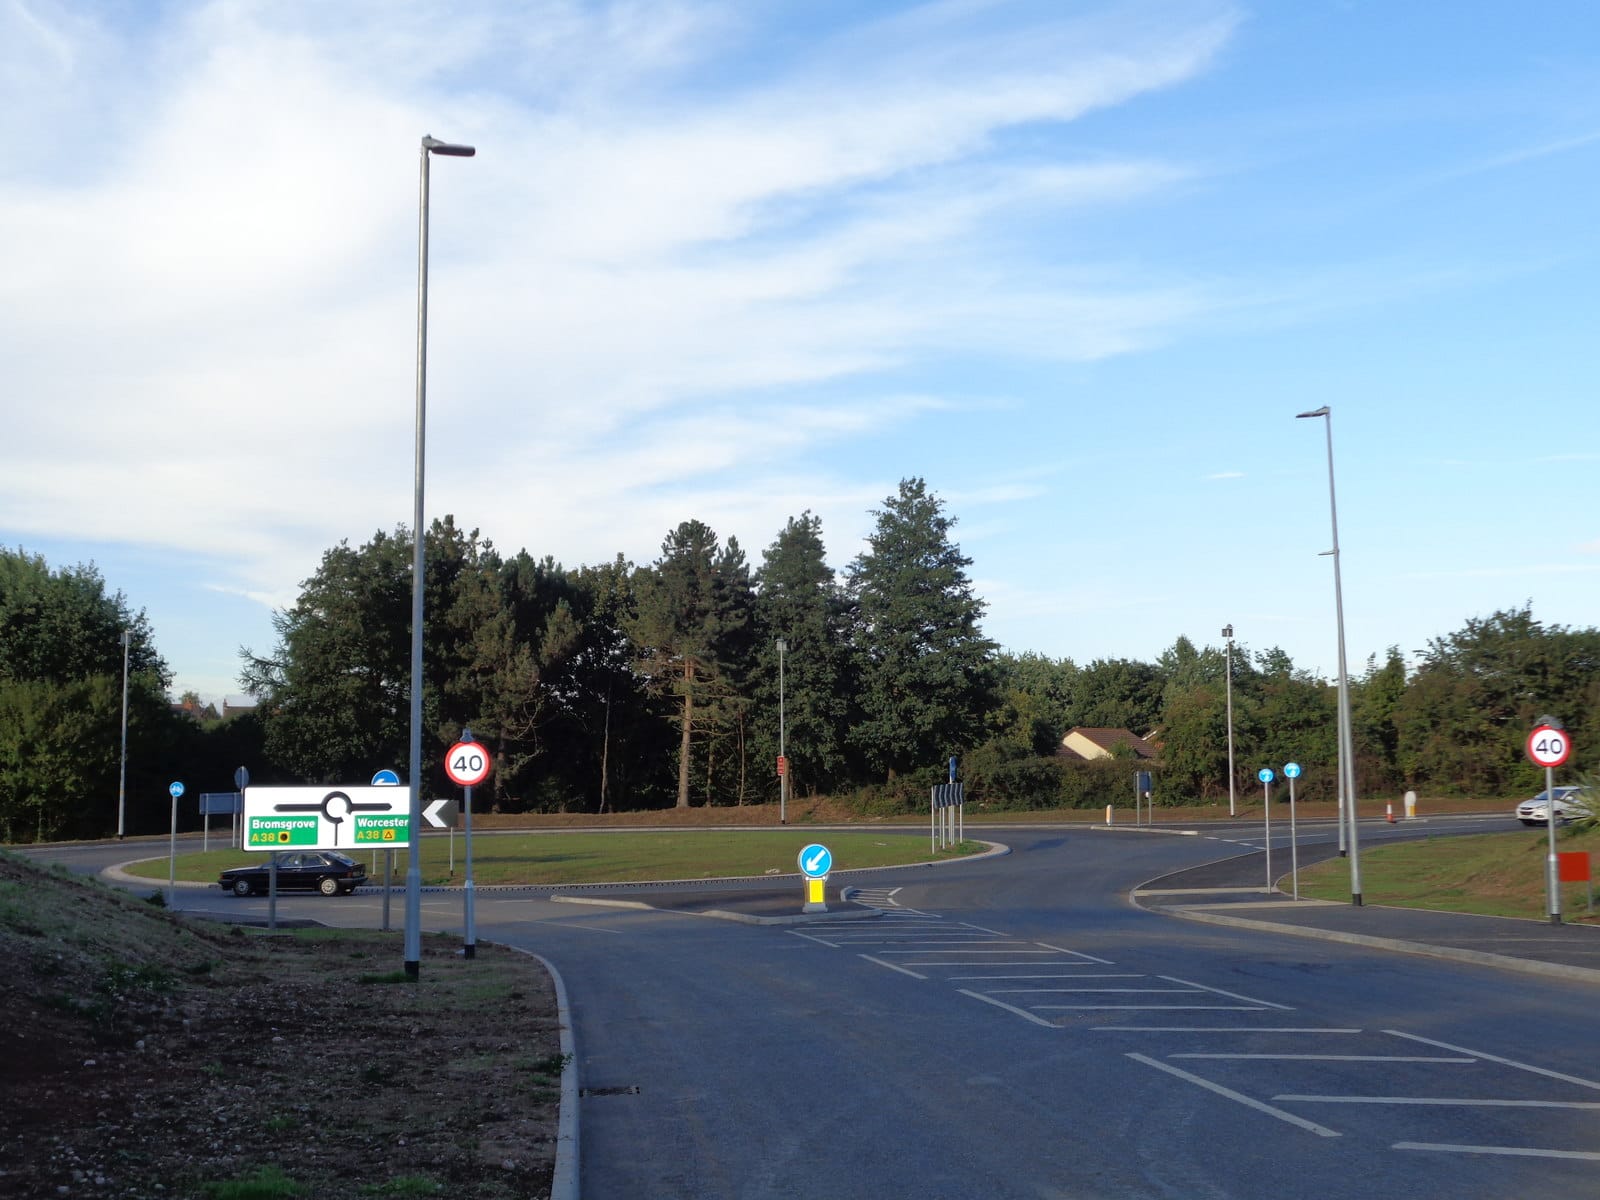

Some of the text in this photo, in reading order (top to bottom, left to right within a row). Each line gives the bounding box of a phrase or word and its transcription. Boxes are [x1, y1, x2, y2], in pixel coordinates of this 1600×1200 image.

[1535, 738, 1563, 755] 40
[453, 755, 483, 772] 40
[252, 819, 315, 830] Bromsgrove
[357, 818, 409, 827] Worcester
